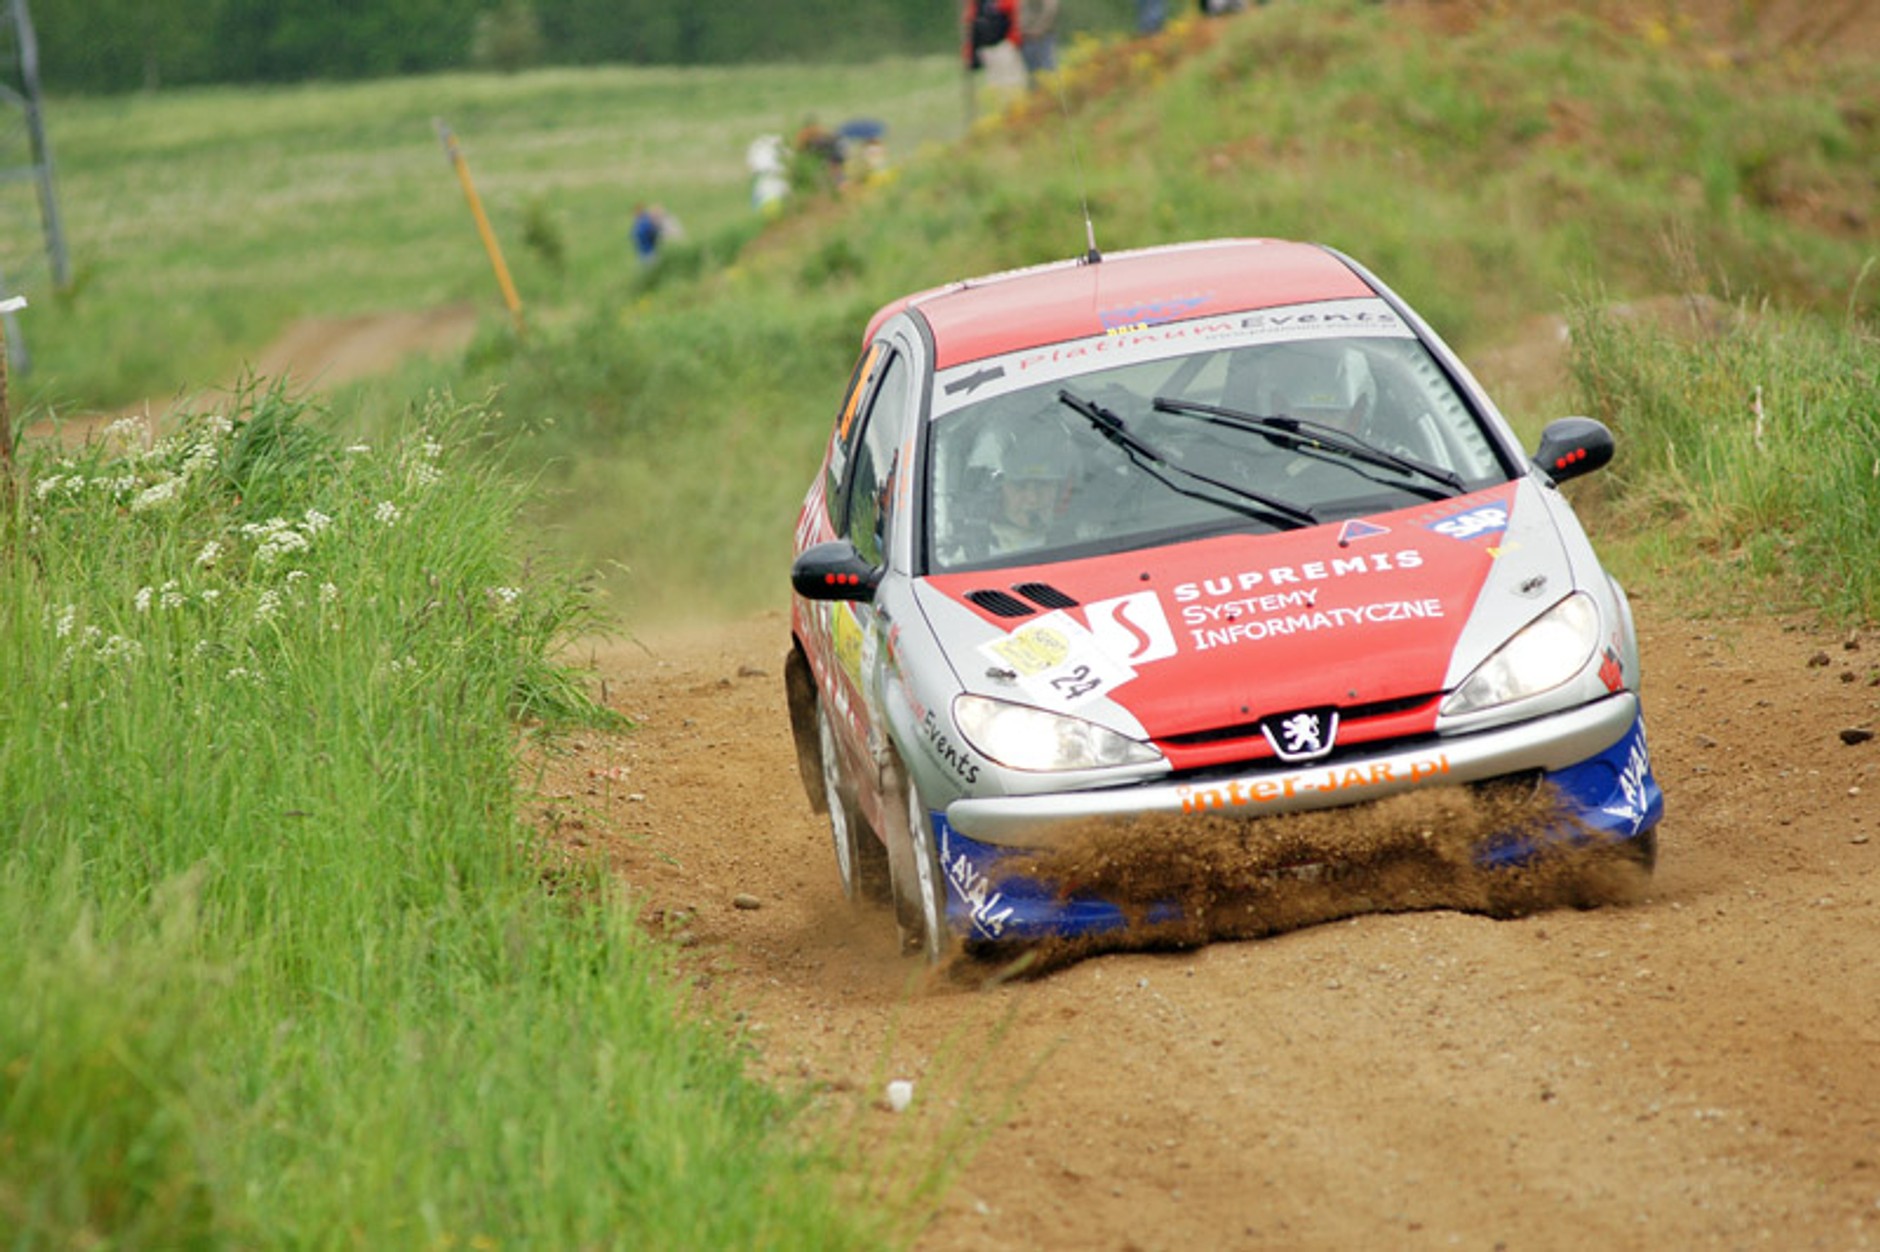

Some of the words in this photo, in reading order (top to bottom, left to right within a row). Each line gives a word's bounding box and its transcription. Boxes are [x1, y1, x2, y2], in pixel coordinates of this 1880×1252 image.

[1433, 507, 1507, 538] SAP
[1173, 549, 1424, 602] SUPREMIS
[1182, 588, 1319, 625] SYSTEMY
[1192, 599, 1444, 650] INFORMATYCZNE
[1049, 664, 1102, 700] 24
